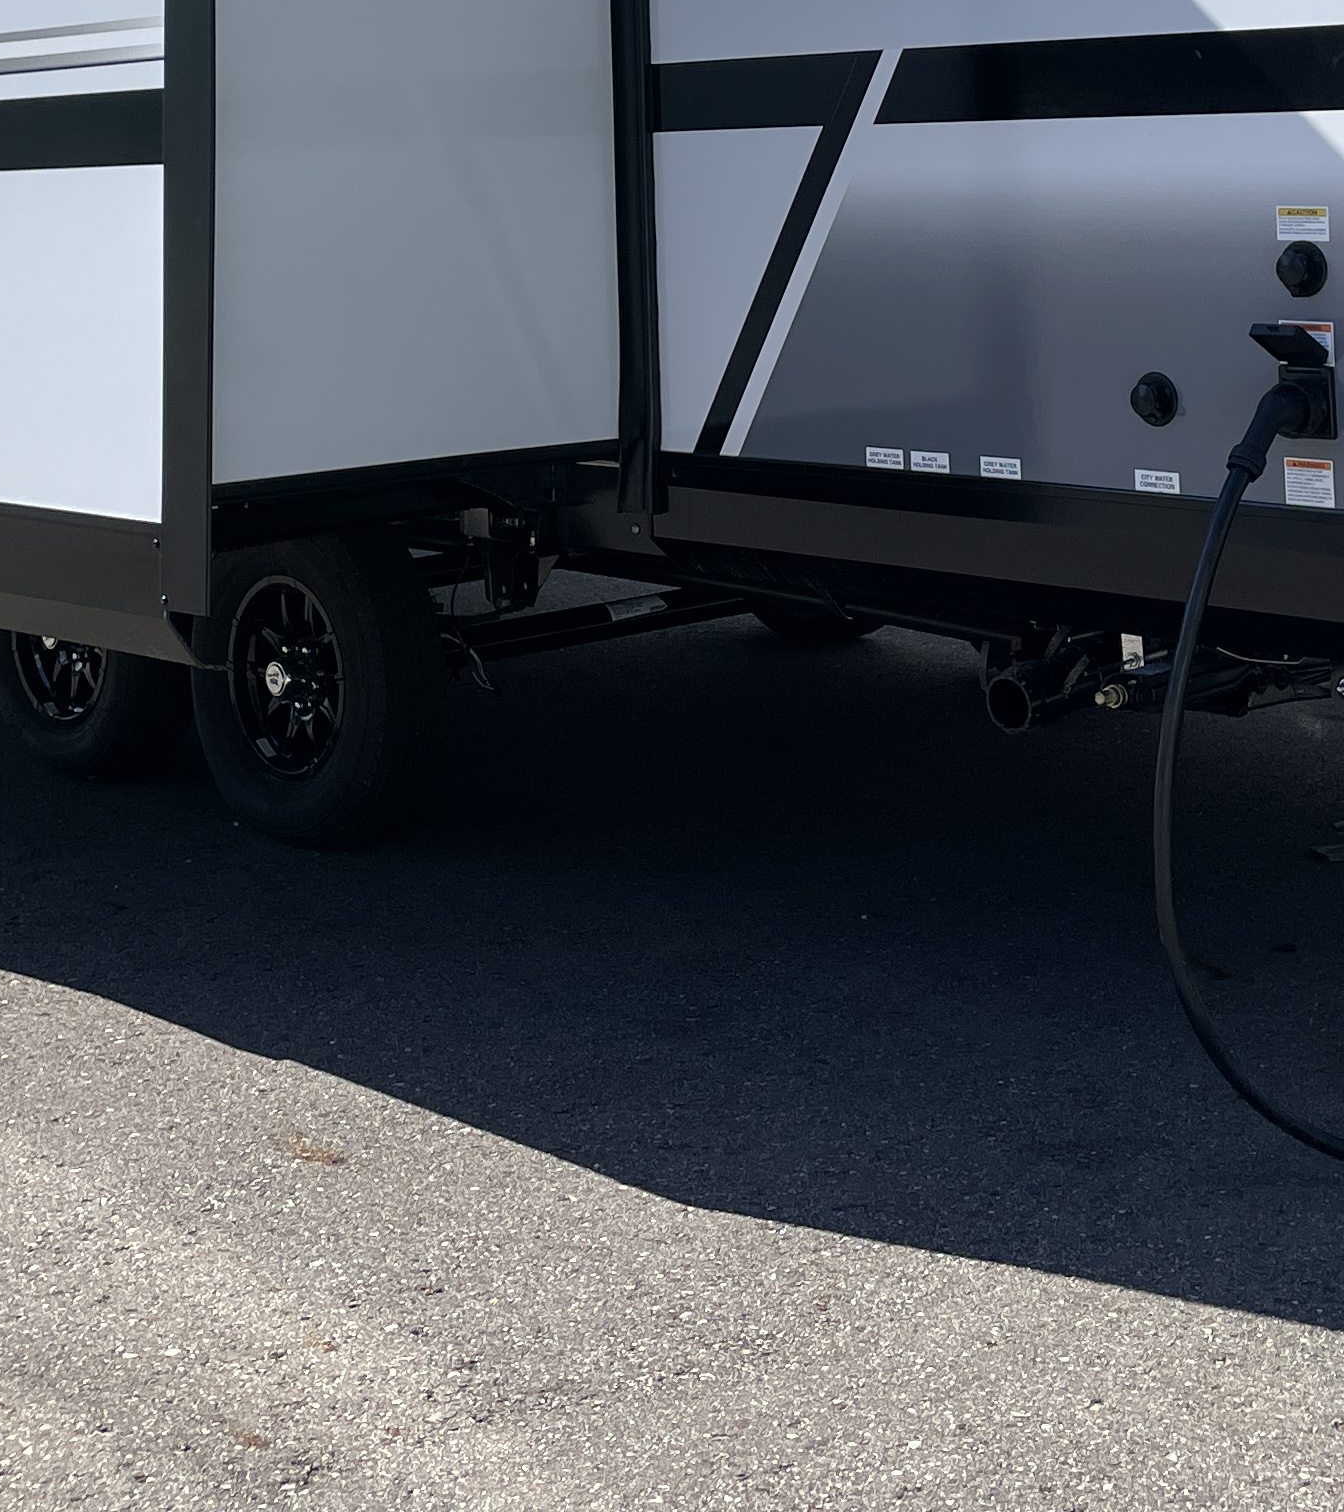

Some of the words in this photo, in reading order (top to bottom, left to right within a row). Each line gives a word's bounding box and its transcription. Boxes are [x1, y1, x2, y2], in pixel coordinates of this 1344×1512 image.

[921, 455, 938, 463] BLACK
[912, 461, 934, 469] HOLDING
[982, 467, 1005, 475] HOLDING
[1005, 468, 1019, 476] TANK
[1140, 473, 1154, 481] CITY
[1154, 475, 1173, 483] WATER
[1139, 480, 1176, 490] CONNECTION
